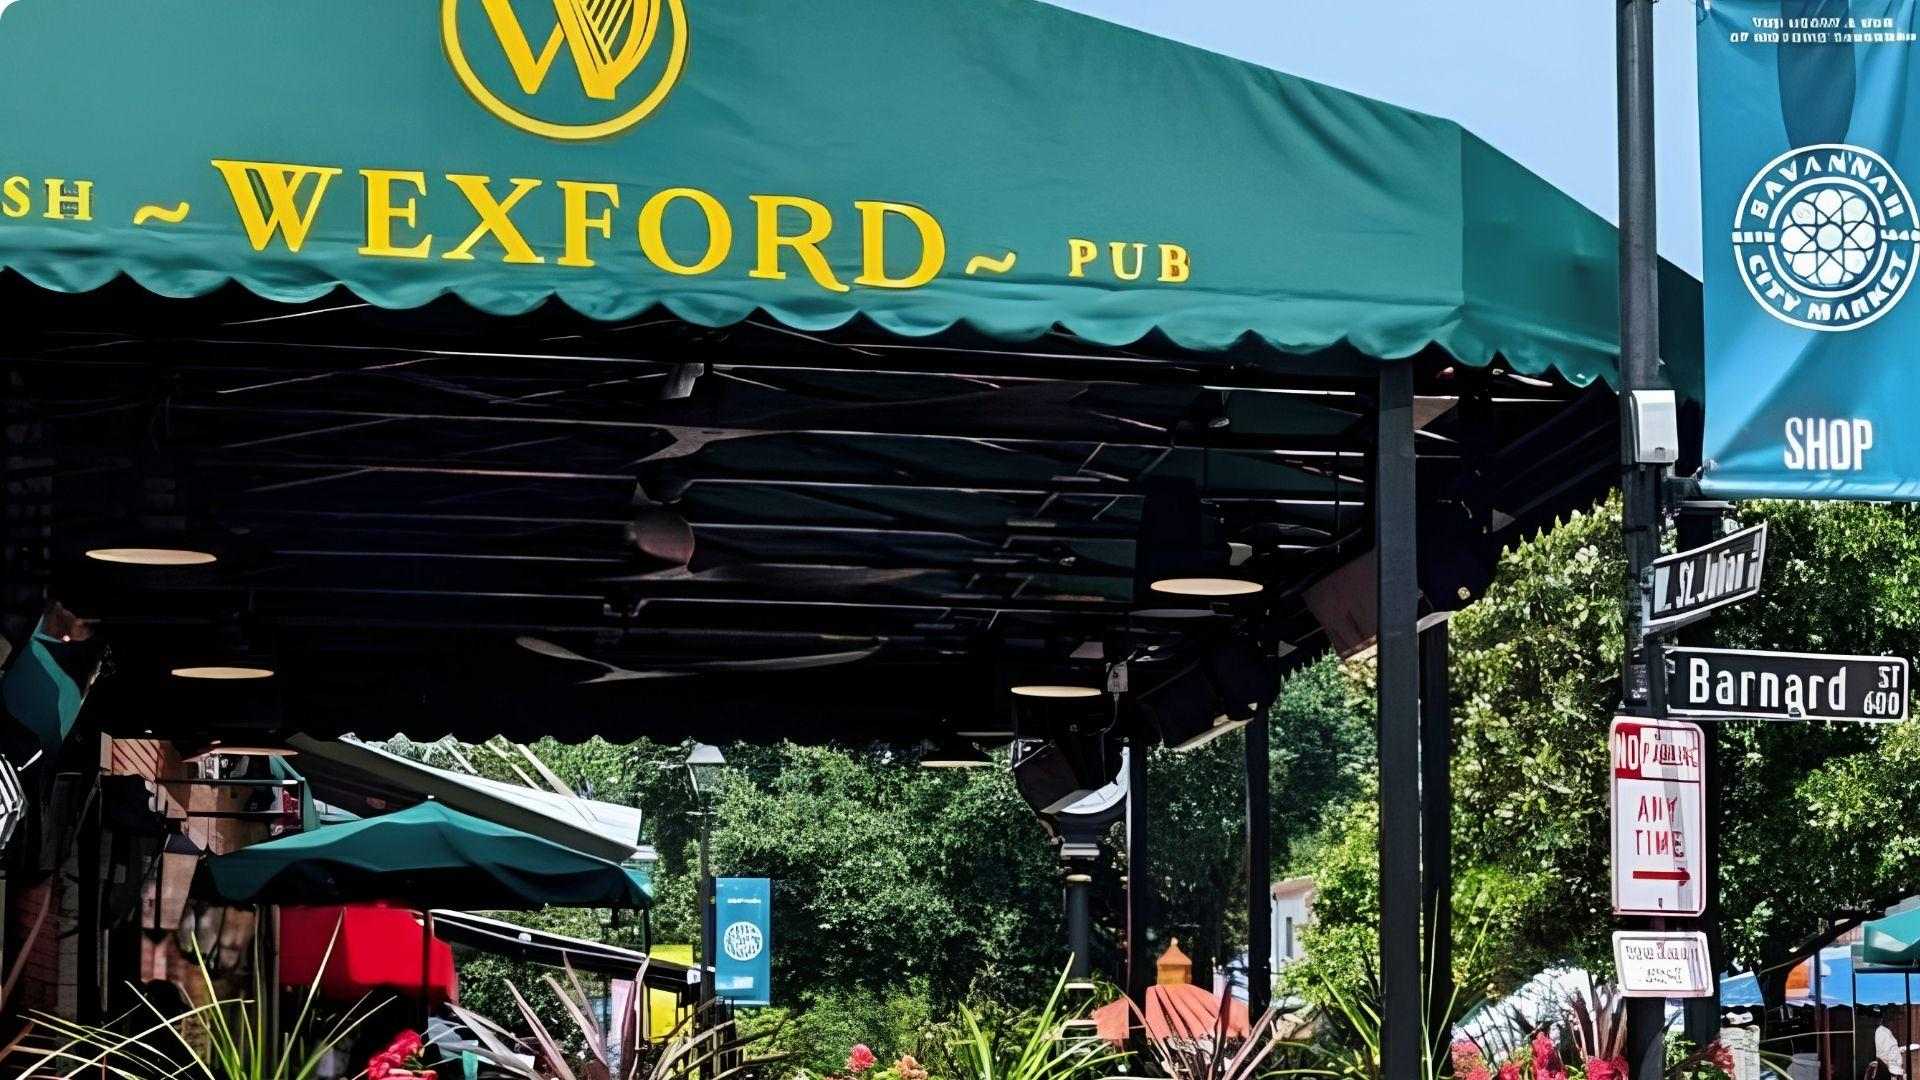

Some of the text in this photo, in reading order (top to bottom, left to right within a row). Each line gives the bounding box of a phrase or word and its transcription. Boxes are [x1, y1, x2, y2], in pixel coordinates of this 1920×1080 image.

[1, 159, 1191, 292] SH WEXFORD PUB
[1749, 254, 1802, 313] CITY
[1783, 416, 1874, 472] SHOP
[1688, 656, 1848, 712] Barnard
[1863, 690, 1900, 716] 600
[1878, 665, 1900, 689] ST
[1615, 731, 1640, 771] NO
